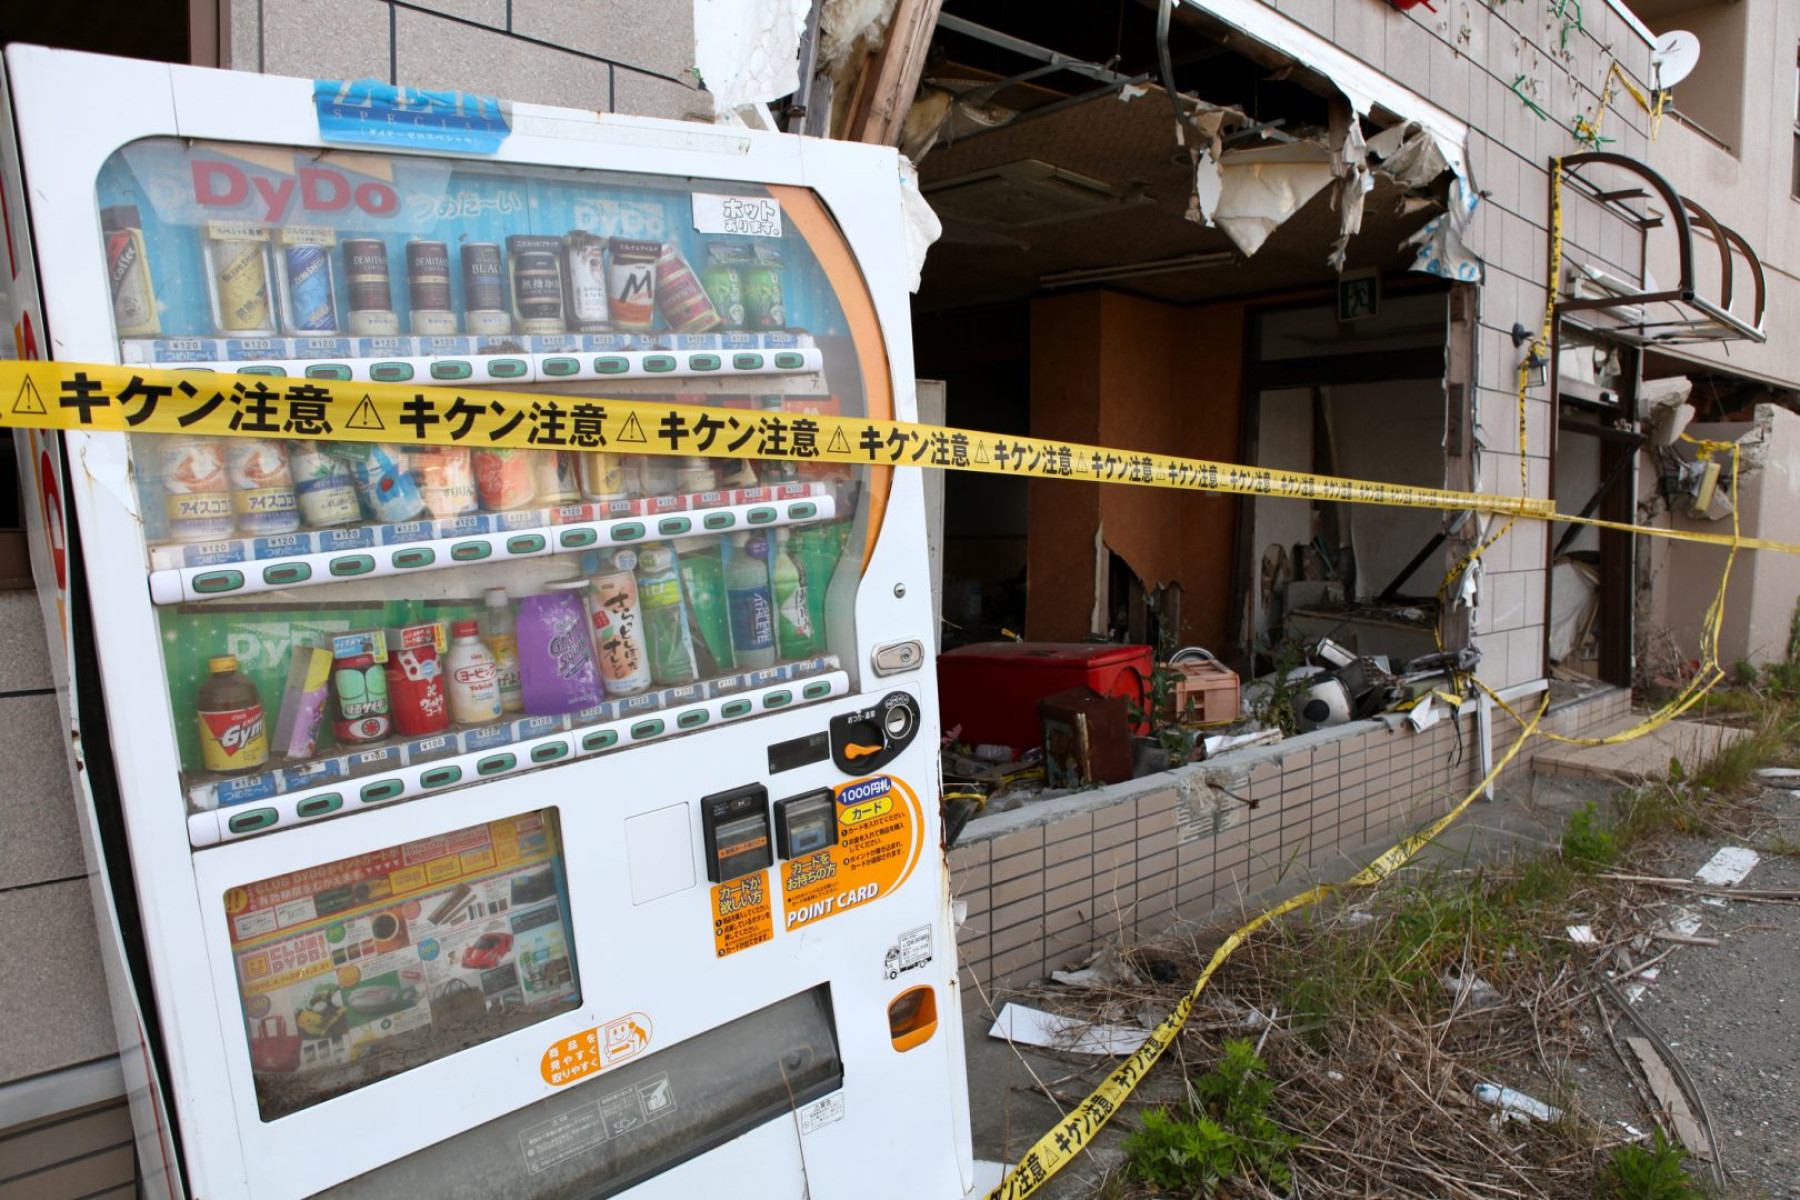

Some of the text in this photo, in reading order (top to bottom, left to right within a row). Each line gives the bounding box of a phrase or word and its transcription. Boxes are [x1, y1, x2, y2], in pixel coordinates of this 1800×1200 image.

[332, 108, 494, 133] SPECIAL
[191, 159, 399, 222] DyDo
[723, 198, 776, 221] ホット
[724, 218, 780, 236] あります。
[173, 341, 199, 349] ¥120
[244, 341, 269, 349] ¥120
[312, 340, 334, 348] ¥120
[375, 339, 396, 347] ¥120
[60, 371, 333, 434] キケン注意
[400, 394, 605, 450] キケン注意
[658, 411, 819, 457] キケン注意
[860, 425, 970, 467] キケン注意
[994, 440, 1073, 476] キケン注意
[1092, 452, 1153, 483] キケン注意
[1168, 461, 1218, 489] キケン注意
[562, 507, 580, 517] ¥120
[335, 531, 358, 539] ¥120
[397, 523, 418, 532] ¥120
[202, 544, 226, 552] ¥120
[271, 537, 294, 546] ¥120
[221, 718, 263, 749] Gym
[842, 779, 891, 803] 1000円札
[852, 801, 882, 821] カード
[791, 852, 831, 876] カードを
[720, 875, 762, 900] カードが
[786, 862, 837, 891] お持ちの方
[719, 889, 763, 915] 欲しい方
[788, 897, 835, 928] POINT
[837, 882, 880, 908] CARD
[549, 1033, 596, 1059] 商品を
[551, 1046, 598, 1071] 見やすく
[552, 1058, 600, 1083] 取りやすく
[1111, 1038, 1164, 1089] キケン注意
[1054, 1095, 1114, 1155] キケン注意
